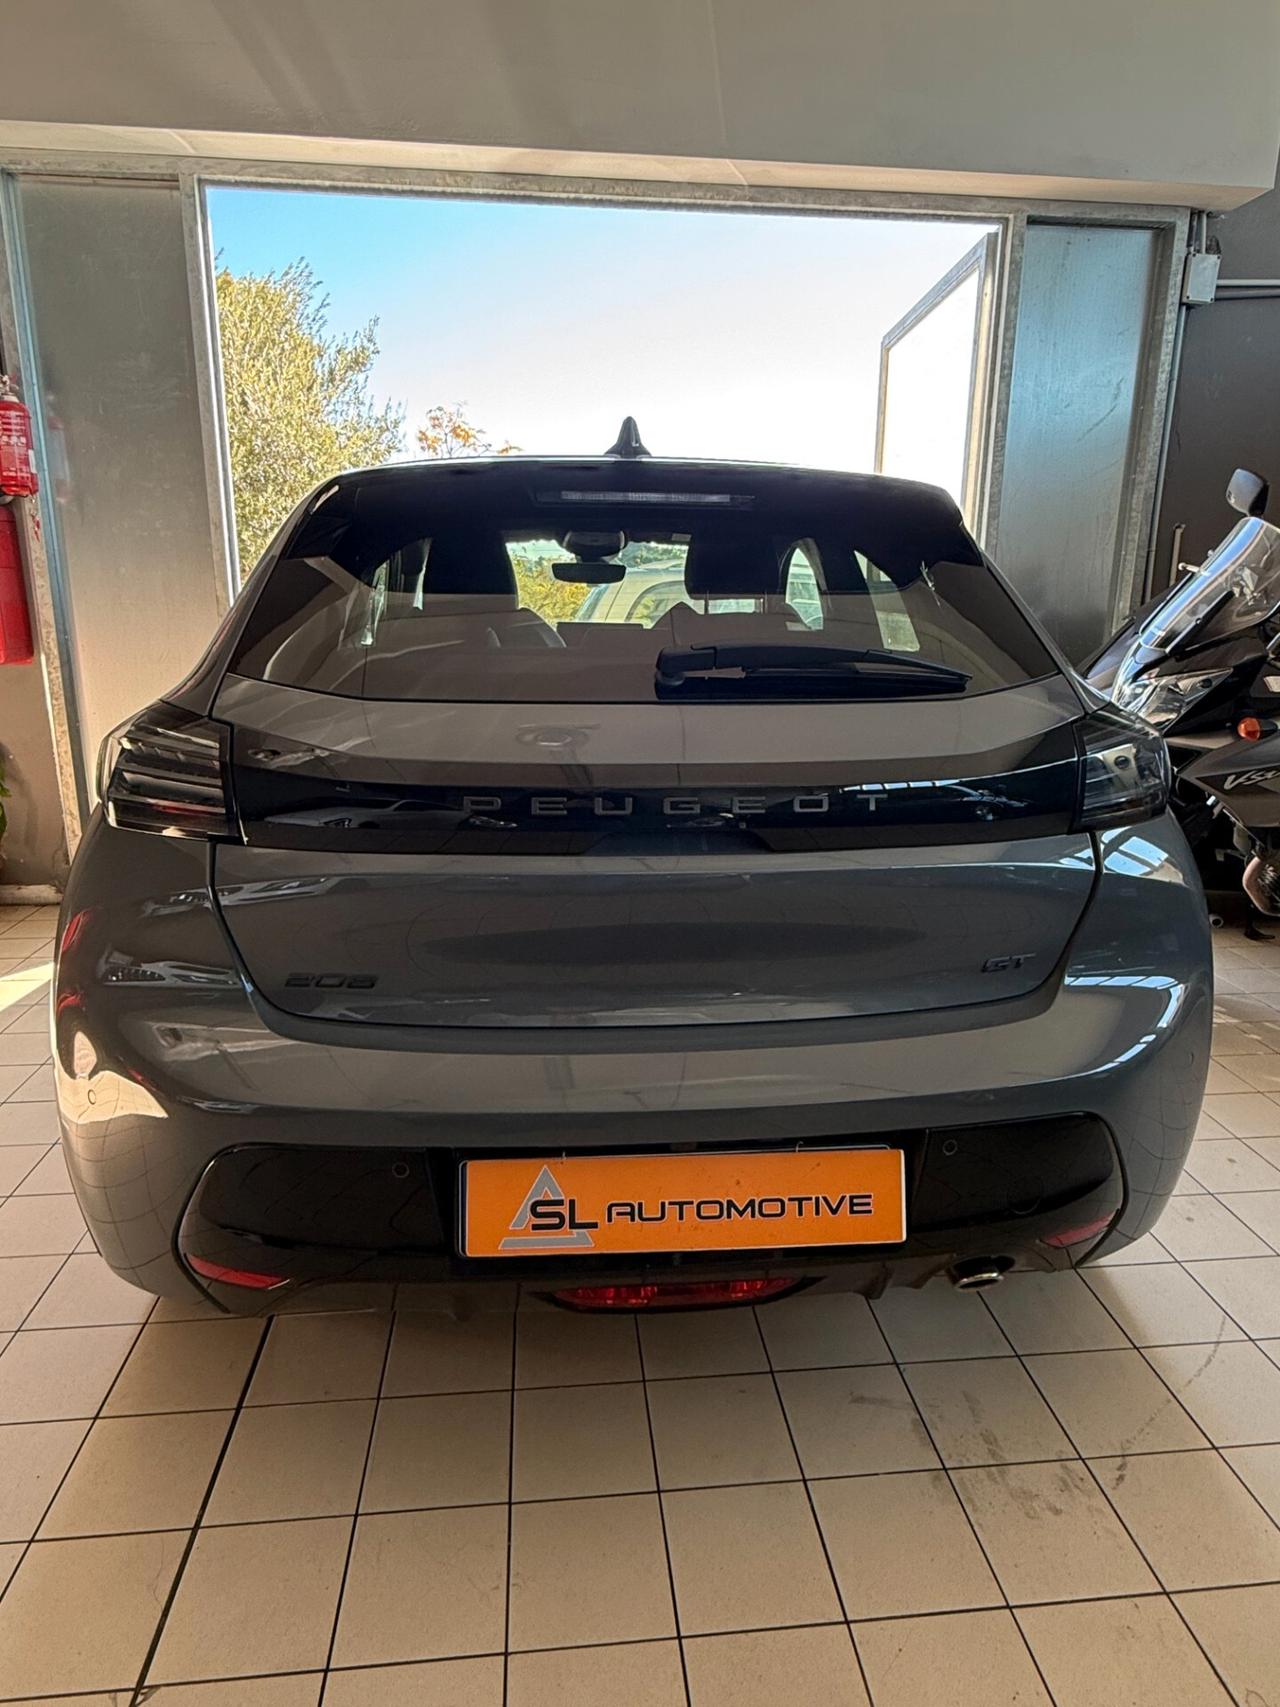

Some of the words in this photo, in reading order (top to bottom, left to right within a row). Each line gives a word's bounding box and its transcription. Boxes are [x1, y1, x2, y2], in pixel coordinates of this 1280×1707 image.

[463, 794, 888, 816] PEUGEOT
[982, 952, 1036, 973] GT
[285, 973, 378, 989] 208
[529, 1198, 599, 1232] SL
[606, 1193, 874, 1224] AUTOMOTIVE
